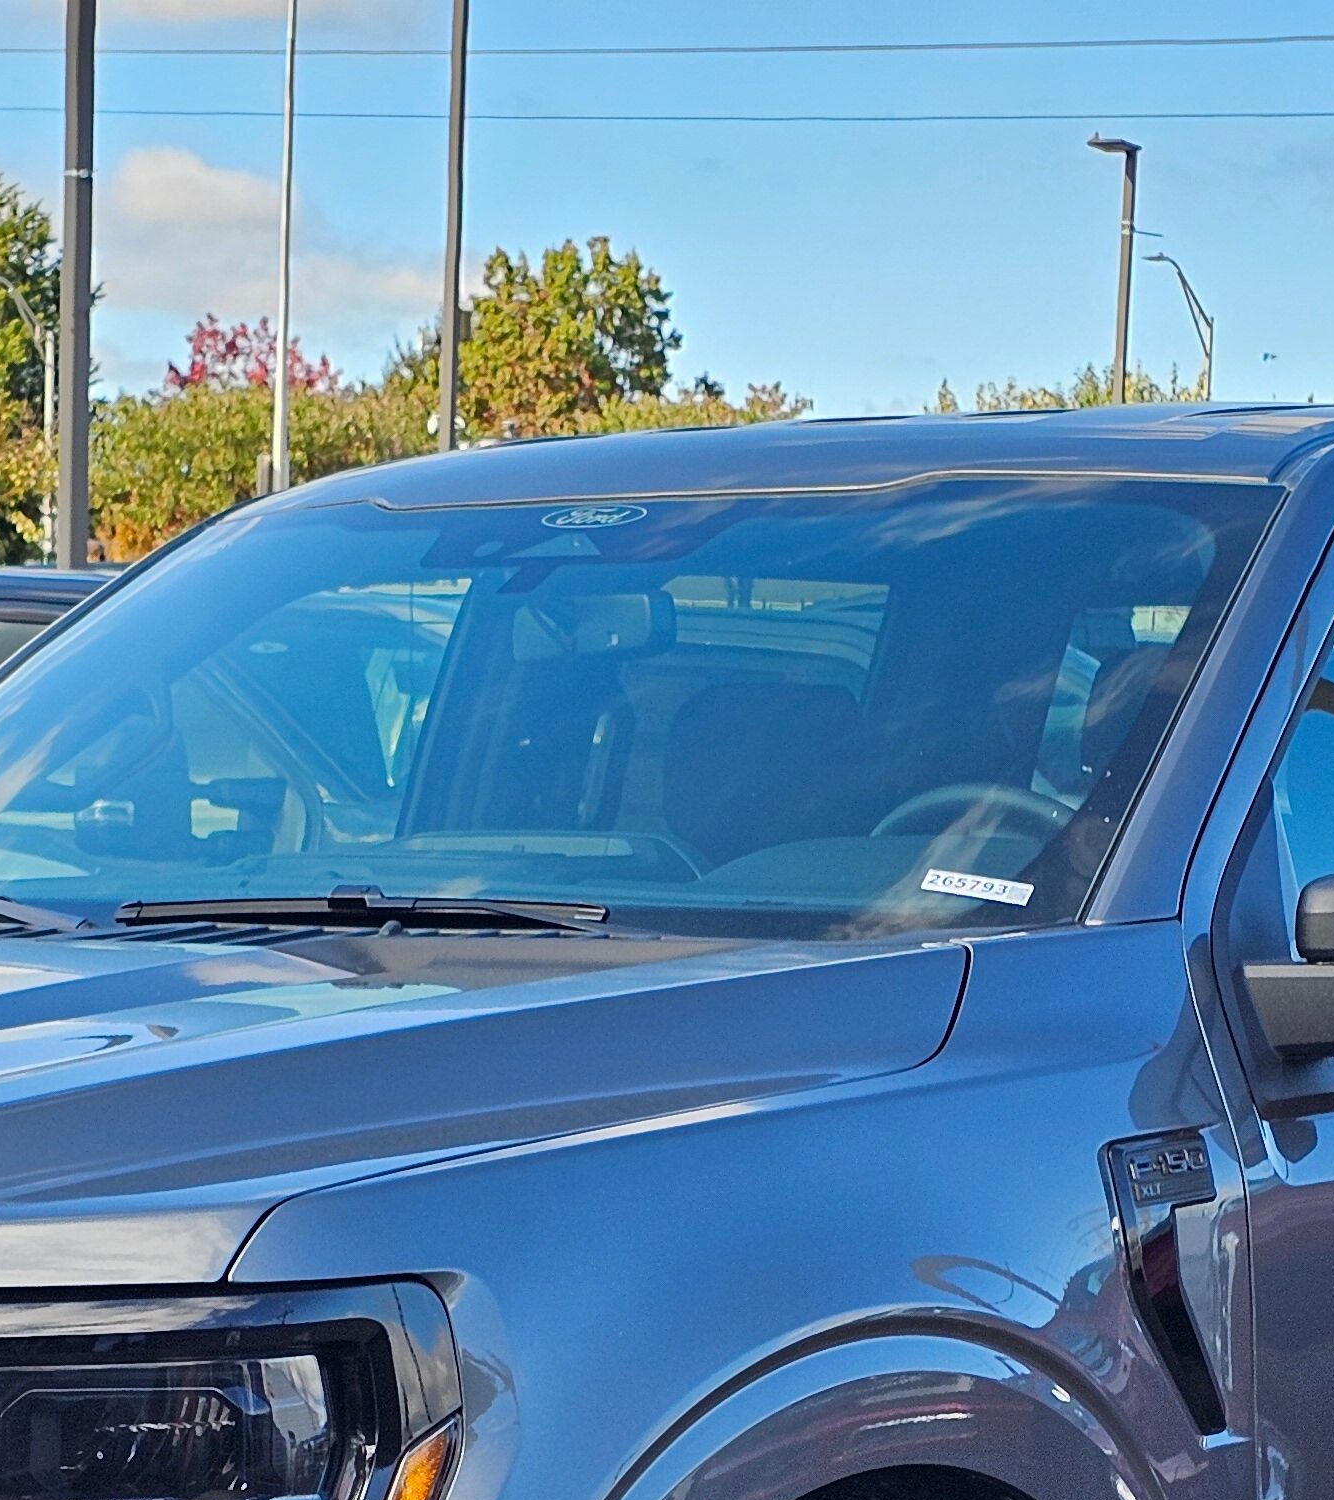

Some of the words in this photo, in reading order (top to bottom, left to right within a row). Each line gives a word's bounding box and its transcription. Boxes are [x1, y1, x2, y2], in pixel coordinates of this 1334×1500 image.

[556, 506, 631, 525] Ford
[927, 873, 1008, 896] 265793
[1129, 1148, 1208, 1181] F-150
[1141, 1182, 1163, 1198] XLT
